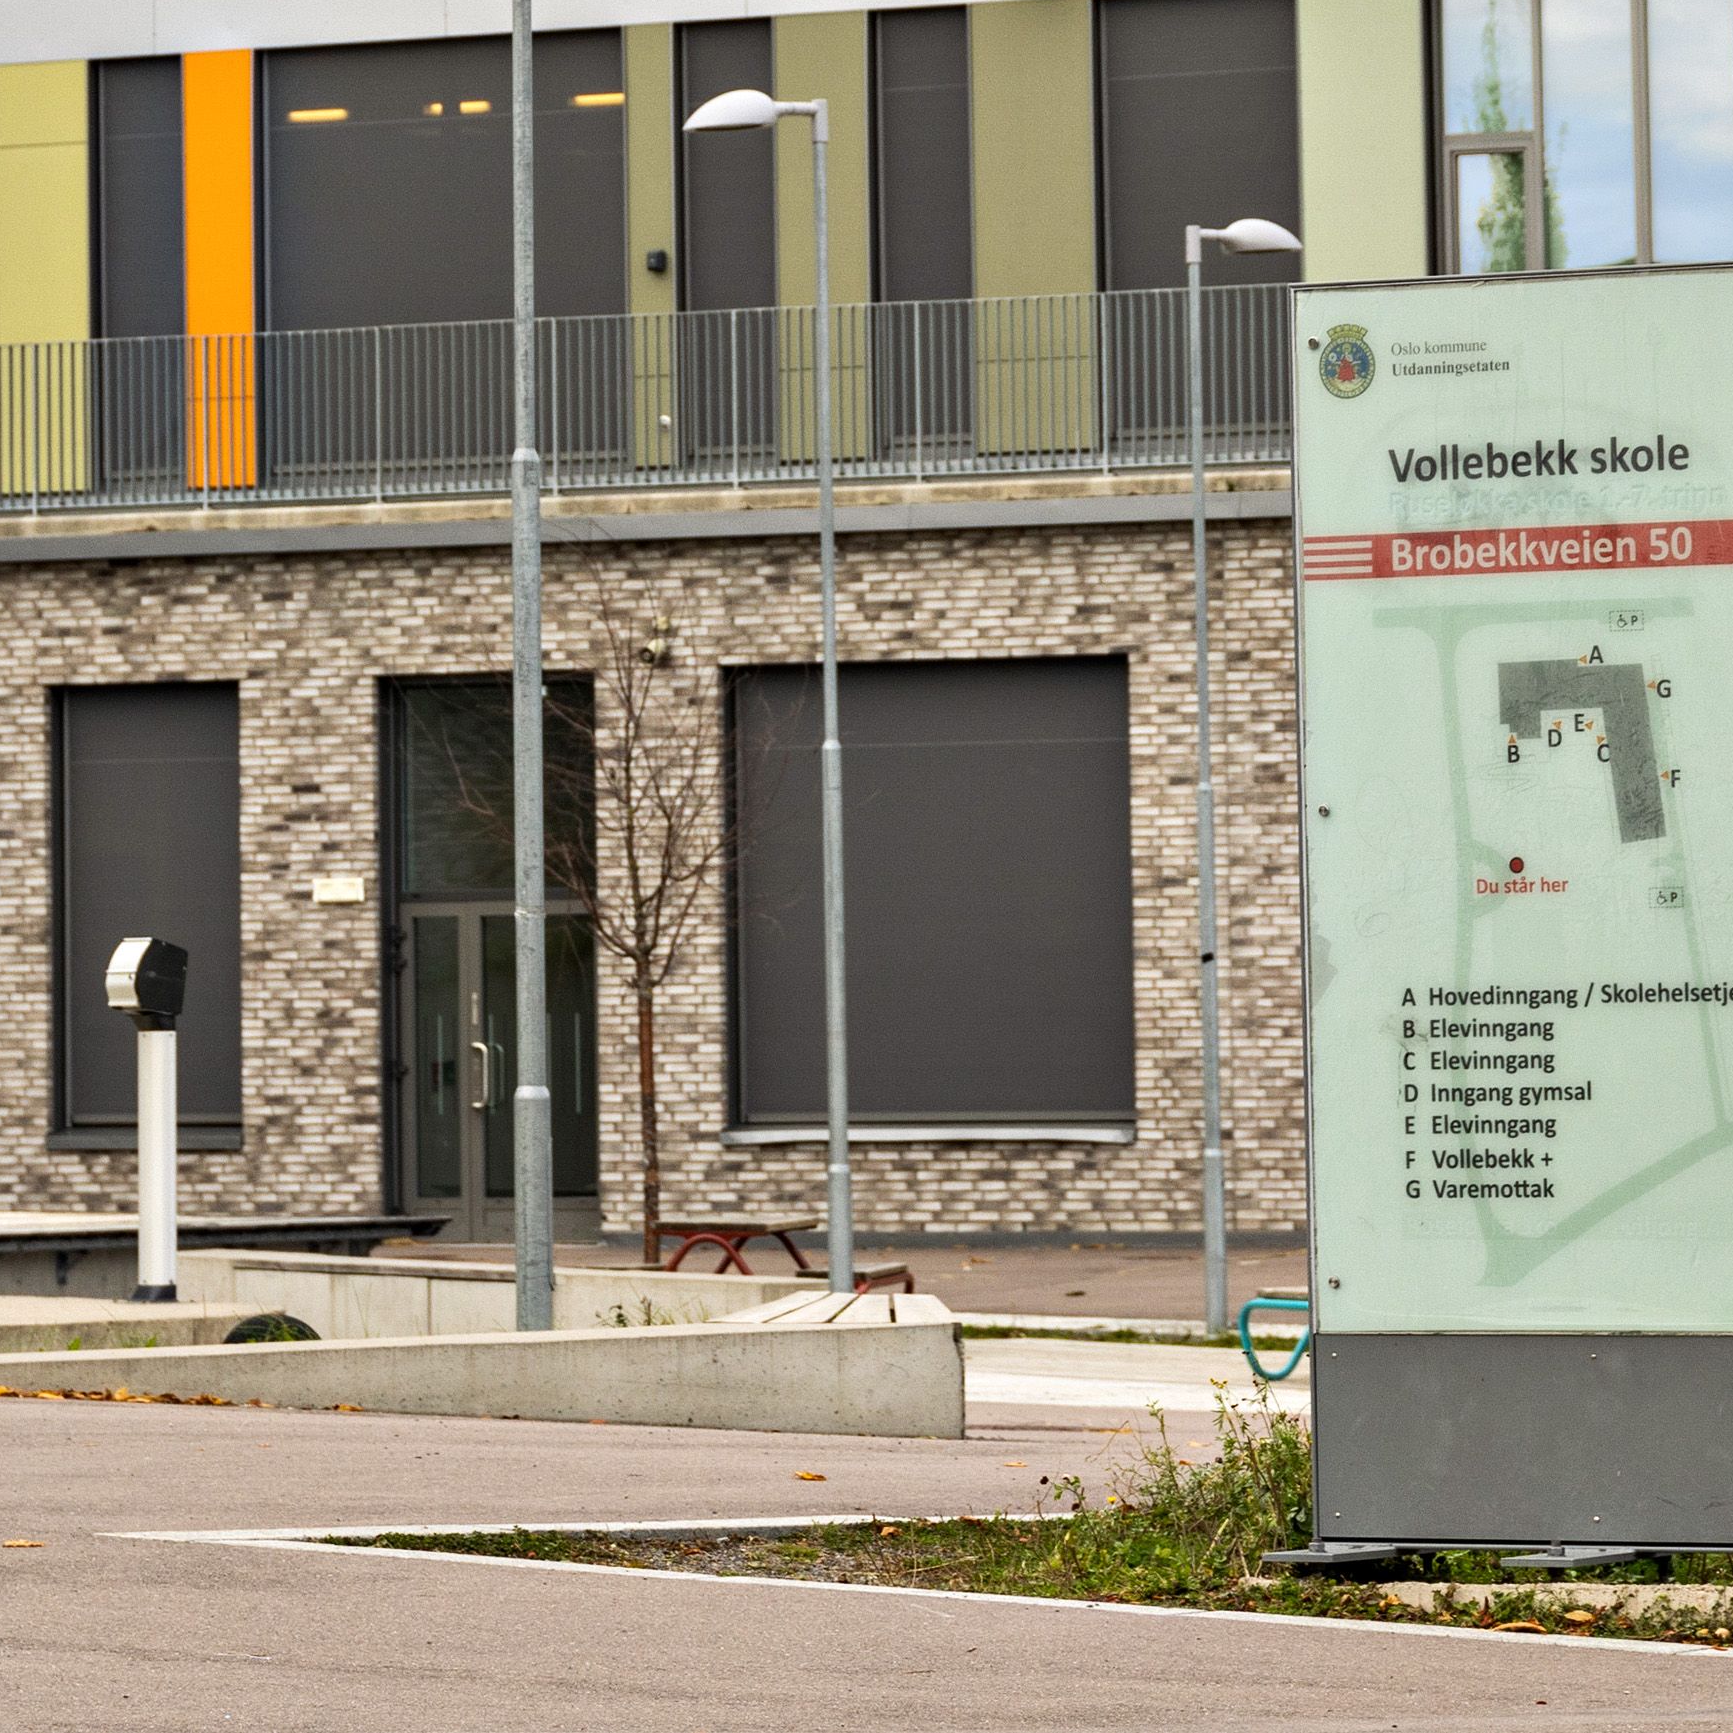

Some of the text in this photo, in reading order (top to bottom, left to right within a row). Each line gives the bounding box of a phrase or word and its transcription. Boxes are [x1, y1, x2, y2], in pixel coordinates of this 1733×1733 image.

[1390, 341, 1487, 356] Oslo kommune
[1392, 360, 1510, 377] Utdanningsetaten
[1388, 434, 1690, 483] Vollebekk skole
[1391, 525, 1692, 572] Brobekkveien 50
[1630, 614, 1639, 625] P
[1588, 645, 1604, 664] A
[1656, 679, 1672, 699] G
[1574, 713, 1585, 733] E
[1547, 728, 1563, 748] D
[1507, 744, 1521, 764] B
[1597, 742, 1612, 763] C
[1670, 769, 1681, 788] F
[1475, 877, 1568, 895] Du står her
[1670, 891, 1678, 903] P
[1401, 987, 1416, 1007] A
[1429, 985, 1578, 1010] Hovedinngang
[1403, 1018, 1555, 1042] B Elevinngang
[1403, 1050, 1555, 1075] C Elevinngang
[1404, 1080, 1592, 1107] D Inngang gymsal
[1405, 1114, 1557, 1139] E Elevinngang
[1405, 1150, 1416, 1170] F
[1431, 1148, 1535, 1169] Vollebekk
[1405, 1178, 1555, 1199] G Varemottak
